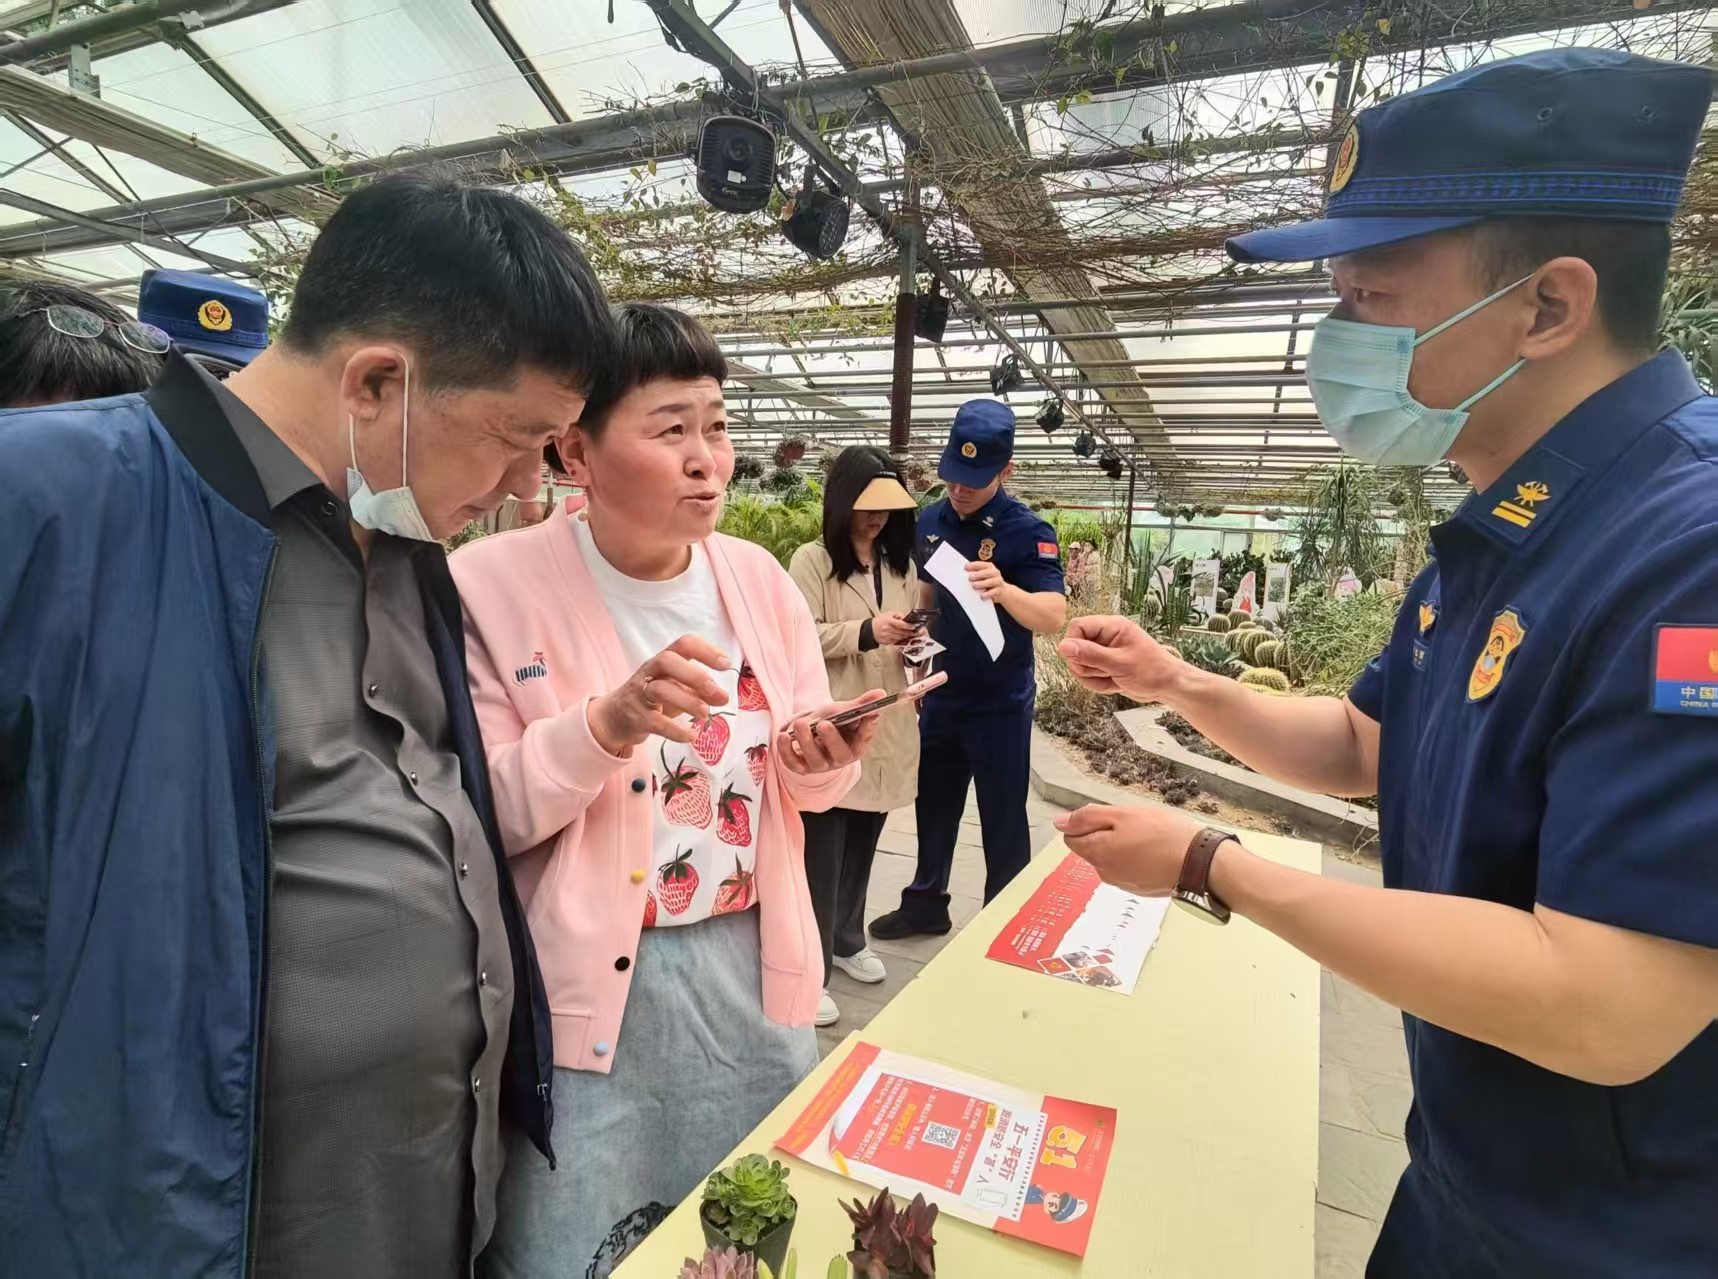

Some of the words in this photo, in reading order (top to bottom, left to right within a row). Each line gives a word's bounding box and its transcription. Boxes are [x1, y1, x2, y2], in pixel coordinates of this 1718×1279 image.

[998, 1122, 1029, 1184] 五一平安行
